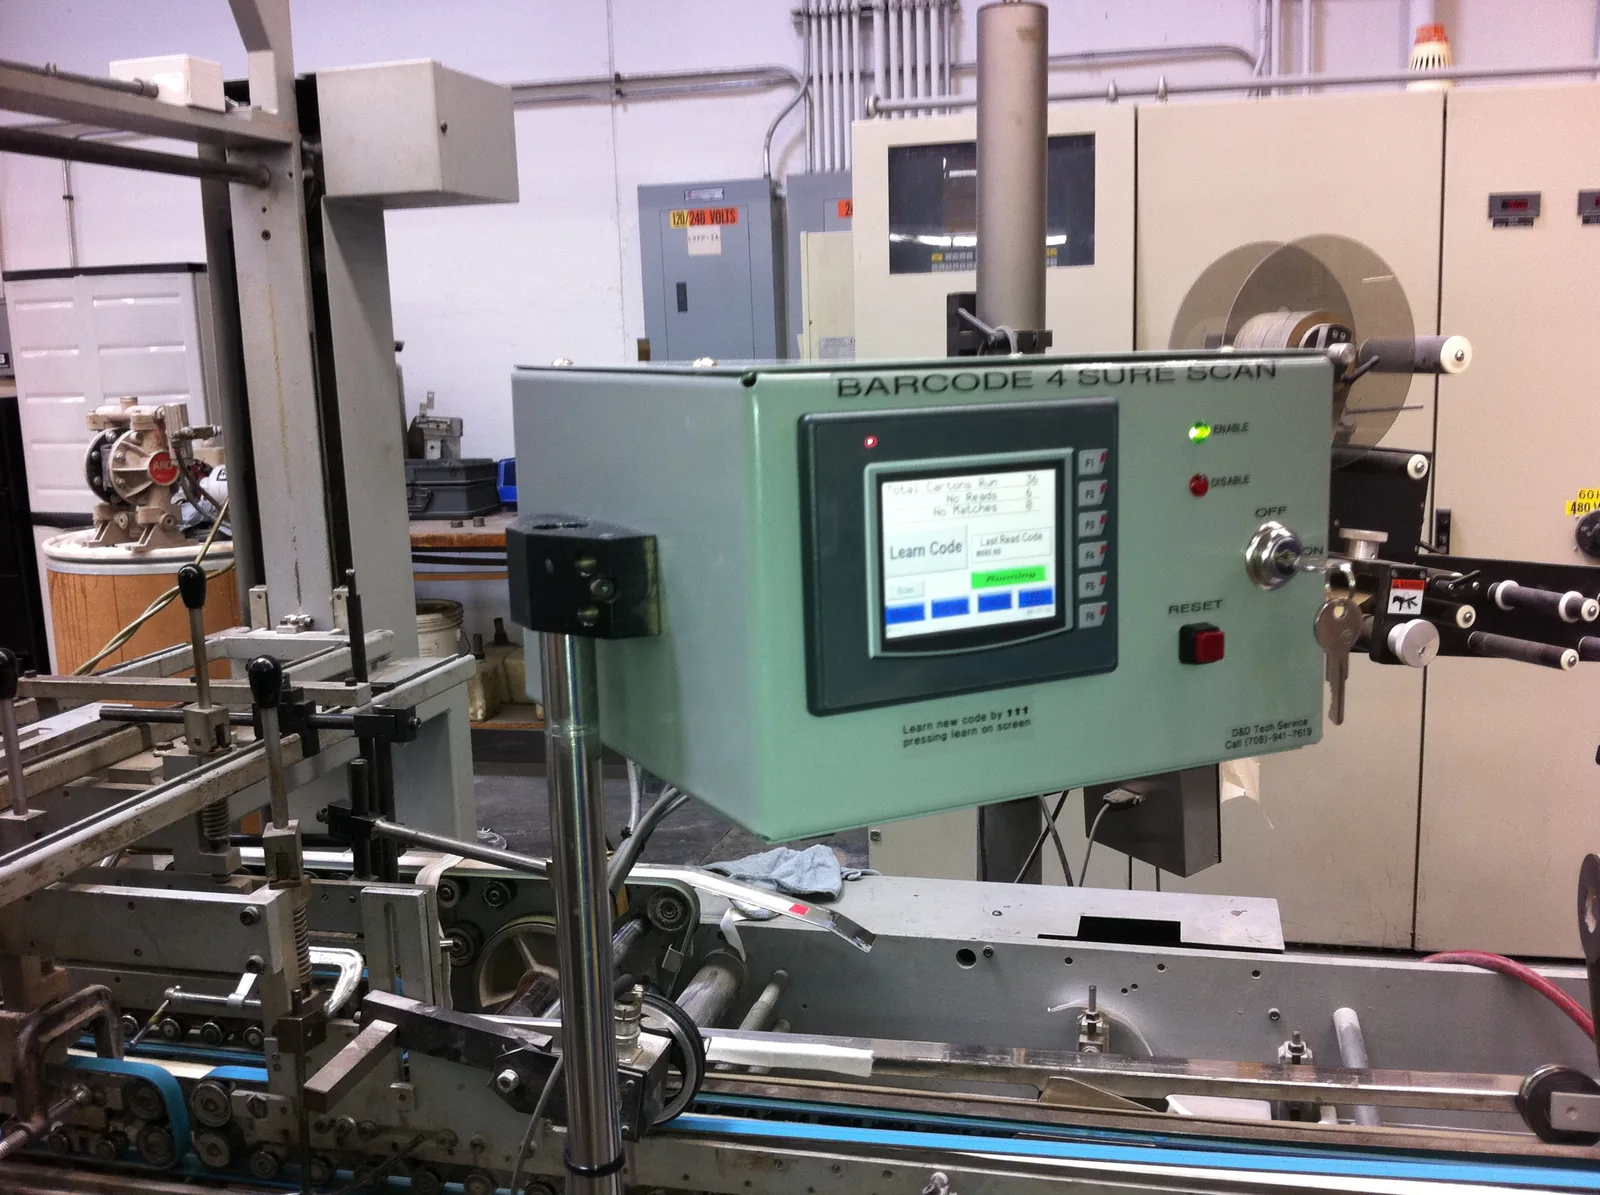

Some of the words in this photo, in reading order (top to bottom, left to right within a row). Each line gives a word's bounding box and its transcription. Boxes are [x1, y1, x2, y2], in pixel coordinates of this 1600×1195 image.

[672, 209, 706, 226] 120/240
[710, 208, 736, 225] VOLTS
[837, 370, 1034, 398] BARCODE
[1047, 369, 1067, 388] 4
[1078, 366, 1175, 386] SURE
[1187, 363, 1277, 381] SCAN
[1212, 422, 1249, 435] ENABLE
[1085, 458, 1095, 468] F1
[887, 483, 918, 495] Total
[927, 481, 972, 493] Cartons
[978, 478, 998, 489] Run
[1210, 474, 1251, 487] DISABLE
[946, 494, 959, 504] No
[966, 491, 998, 503] Reads
[1085, 489, 1095, 499] F2
[933, 507, 947, 517] No
[953, 503, 998, 516] Matches
[1254, 505, 1287, 518] OFF
[980, 536, 998, 548] Last
[1000, 533, 1020, 545] Read
[1022, 531, 1043, 543] Code
[890, 545, 925, 560] Learn
[930, 539, 963, 556] Code
[1302, 546, 1324, 556] ON
[986, 571, 1037, 584] Running
[1168, 600, 1223, 615] RESET
[902, 721, 933, 735] Learn
[936, 718, 958, 729] new
[961, 712, 987, 725] code
[990, 709, 1004, 722] by
[1253, 722, 1275, 734] Tech
[1277, 718, 1309, 730] Service
[903, 730, 948, 749] pressing
[951, 725, 978, 739] learn
[981, 723, 994, 734] on
[997, 717, 1032, 732] screen
[1225, 739, 1242, 750] Call
